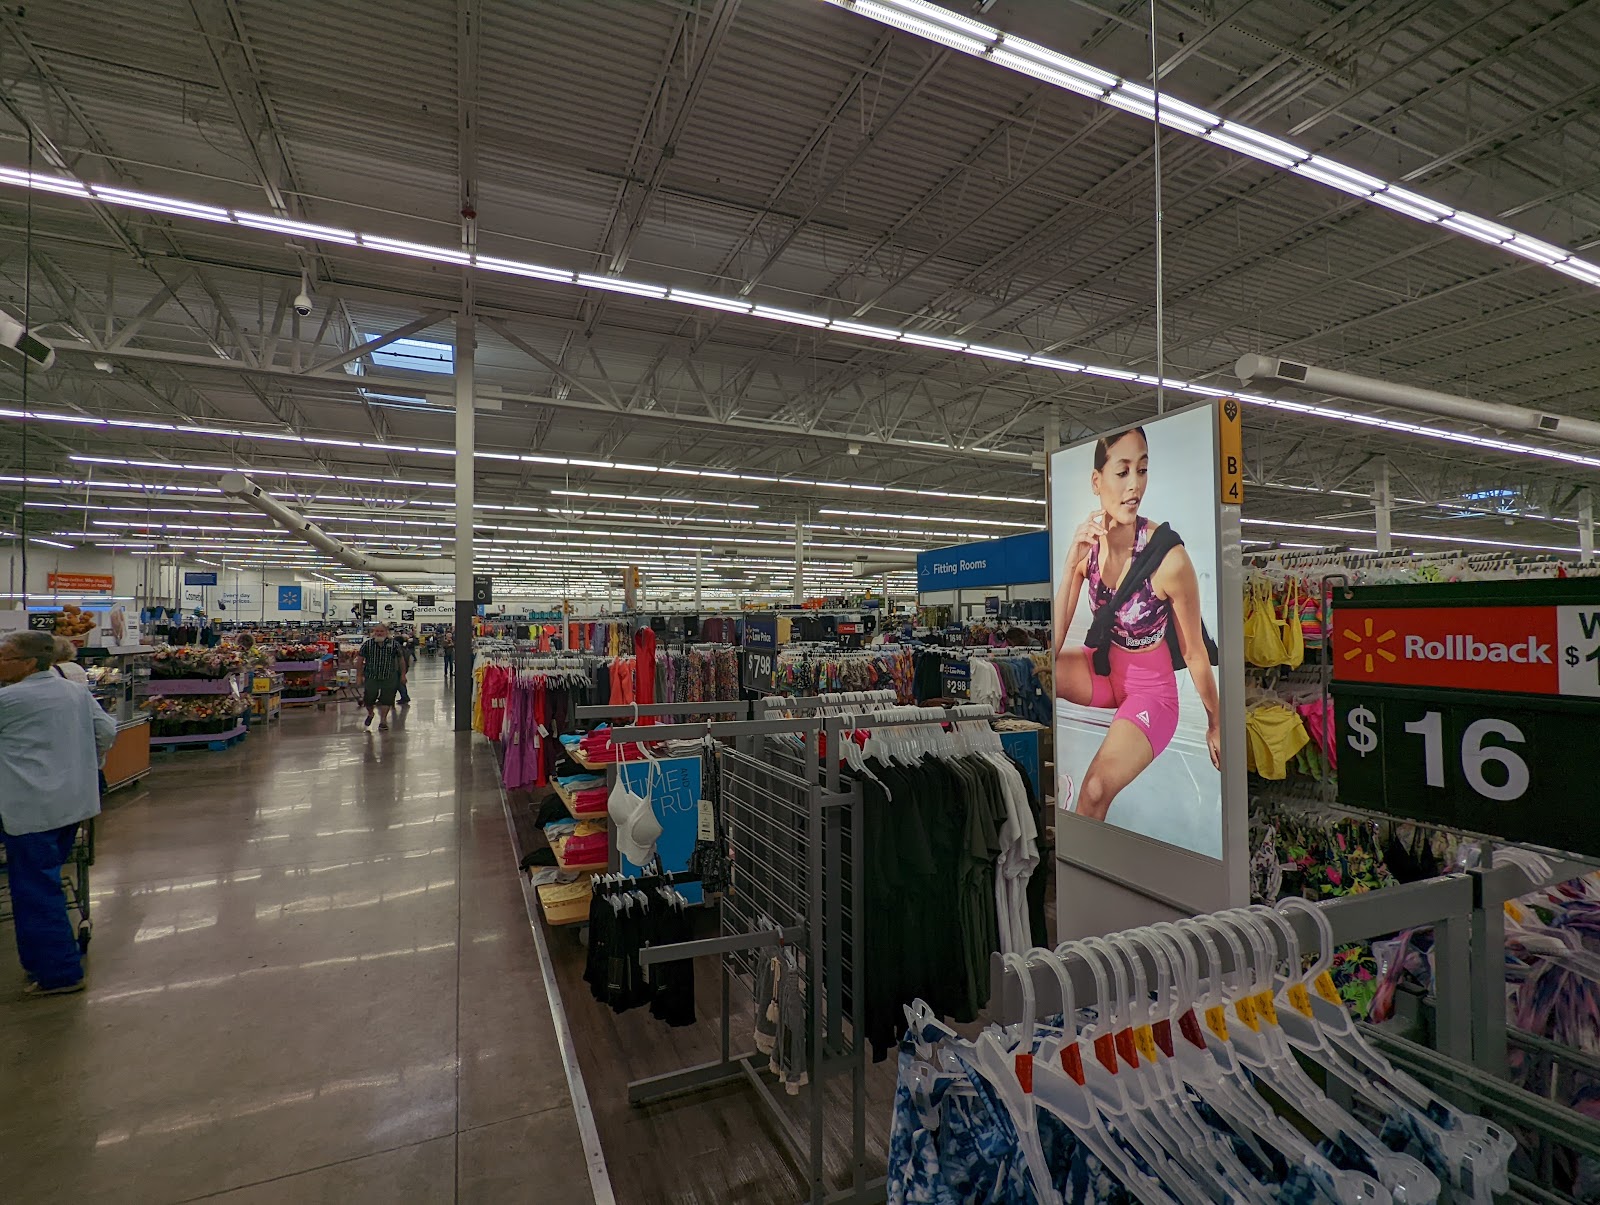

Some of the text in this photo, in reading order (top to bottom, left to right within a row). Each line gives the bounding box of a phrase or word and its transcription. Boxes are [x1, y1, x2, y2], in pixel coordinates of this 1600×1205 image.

[1228, 456, 1237, 475] B
[1229, 482, 1239, 499] 4
[933, 559, 987, 575] Fitting Rooms
[752, 632, 772, 643] Low Price
[1405, 634, 1553, 664] Rollback
[622, 769, 682, 800] TIME
[680, 768, 690, 788] AND
[651, 789, 694, 817] RU
